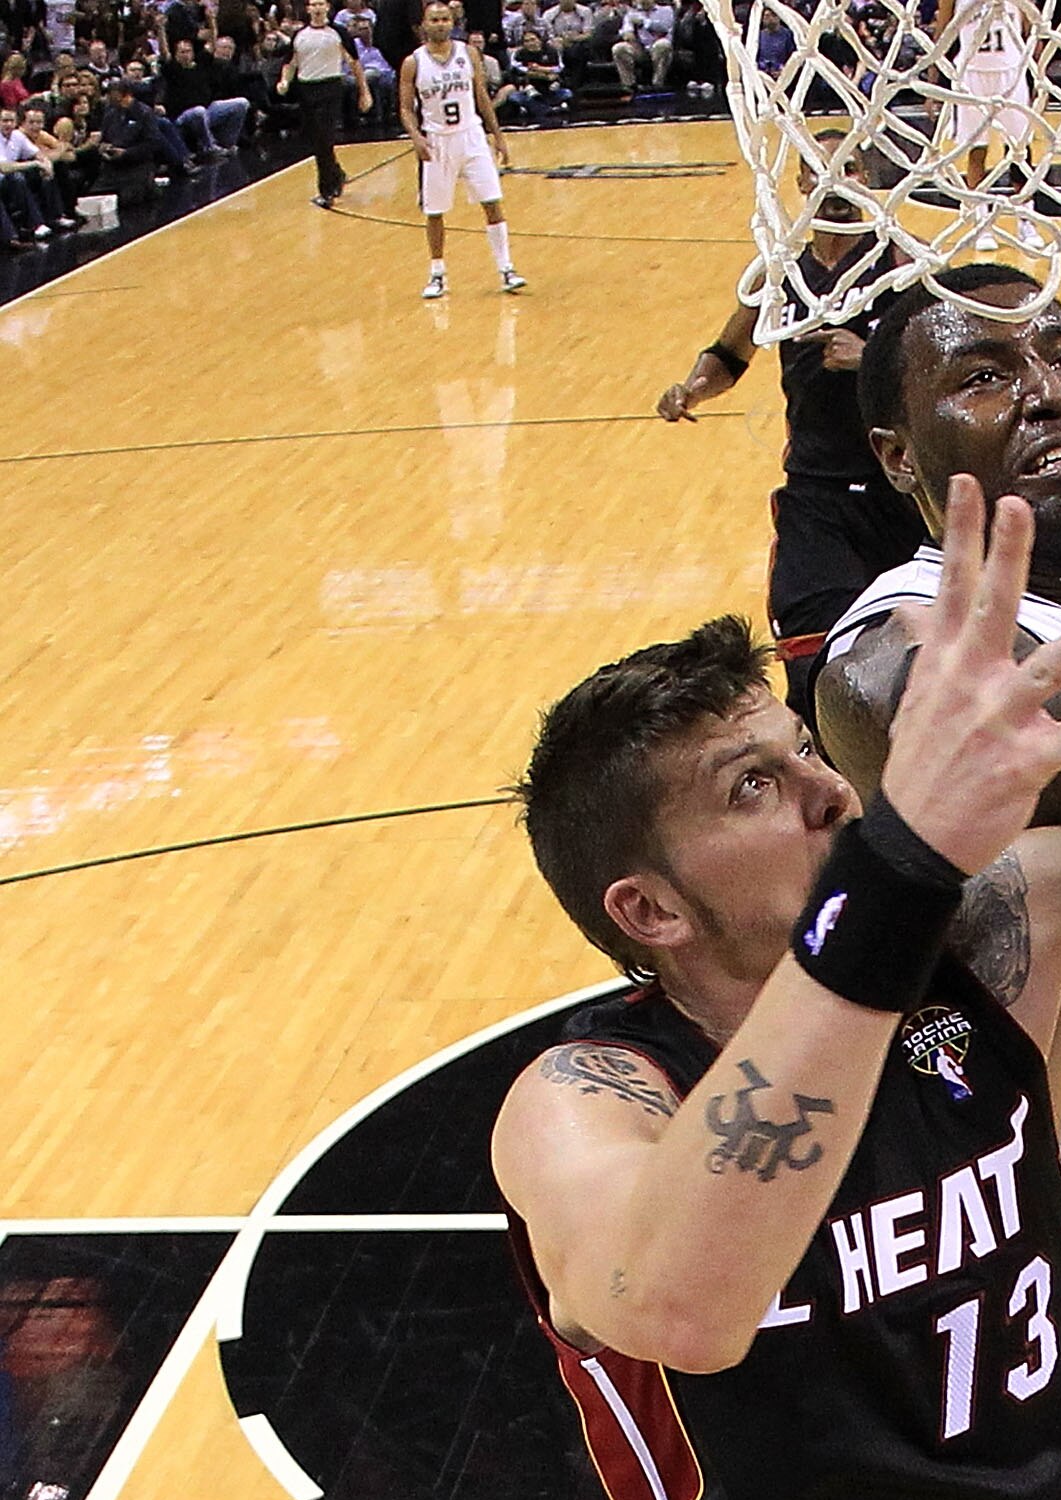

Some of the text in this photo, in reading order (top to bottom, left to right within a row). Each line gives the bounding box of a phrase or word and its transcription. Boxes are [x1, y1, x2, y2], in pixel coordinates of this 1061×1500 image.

[444, 102, 460, 124] 9
[831, 1093, 1030, 1315] HEAT
[934, 1254, 1060, 1441] 13
